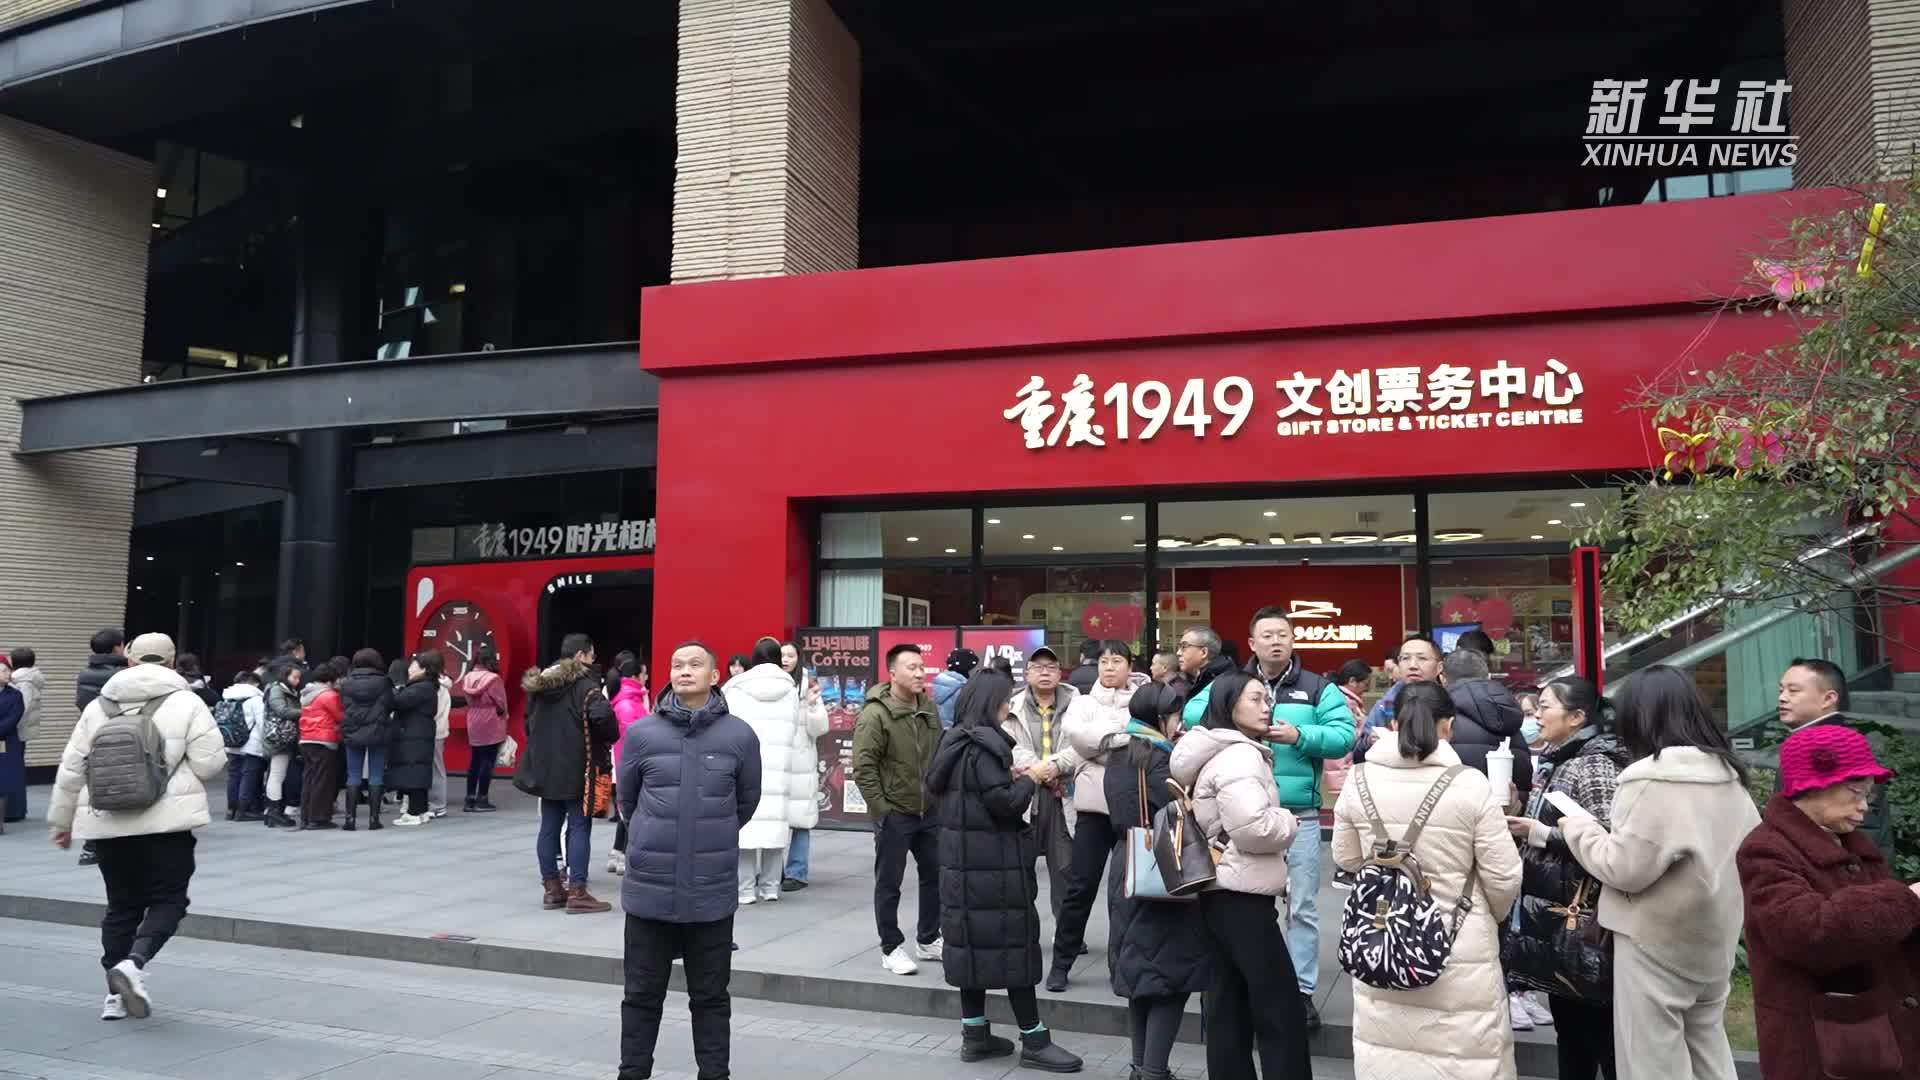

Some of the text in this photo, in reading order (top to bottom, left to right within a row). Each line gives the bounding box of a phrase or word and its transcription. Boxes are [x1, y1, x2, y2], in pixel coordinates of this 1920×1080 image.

[1275, 358, 1584, 418] 文创票务中心
[1277, 408, 1584, 436] GIFT STORE & TICKET CENTRE
[811, 652, 870, 667] Coffee
[1415, 774, 1453, 827] ANFUMAN
